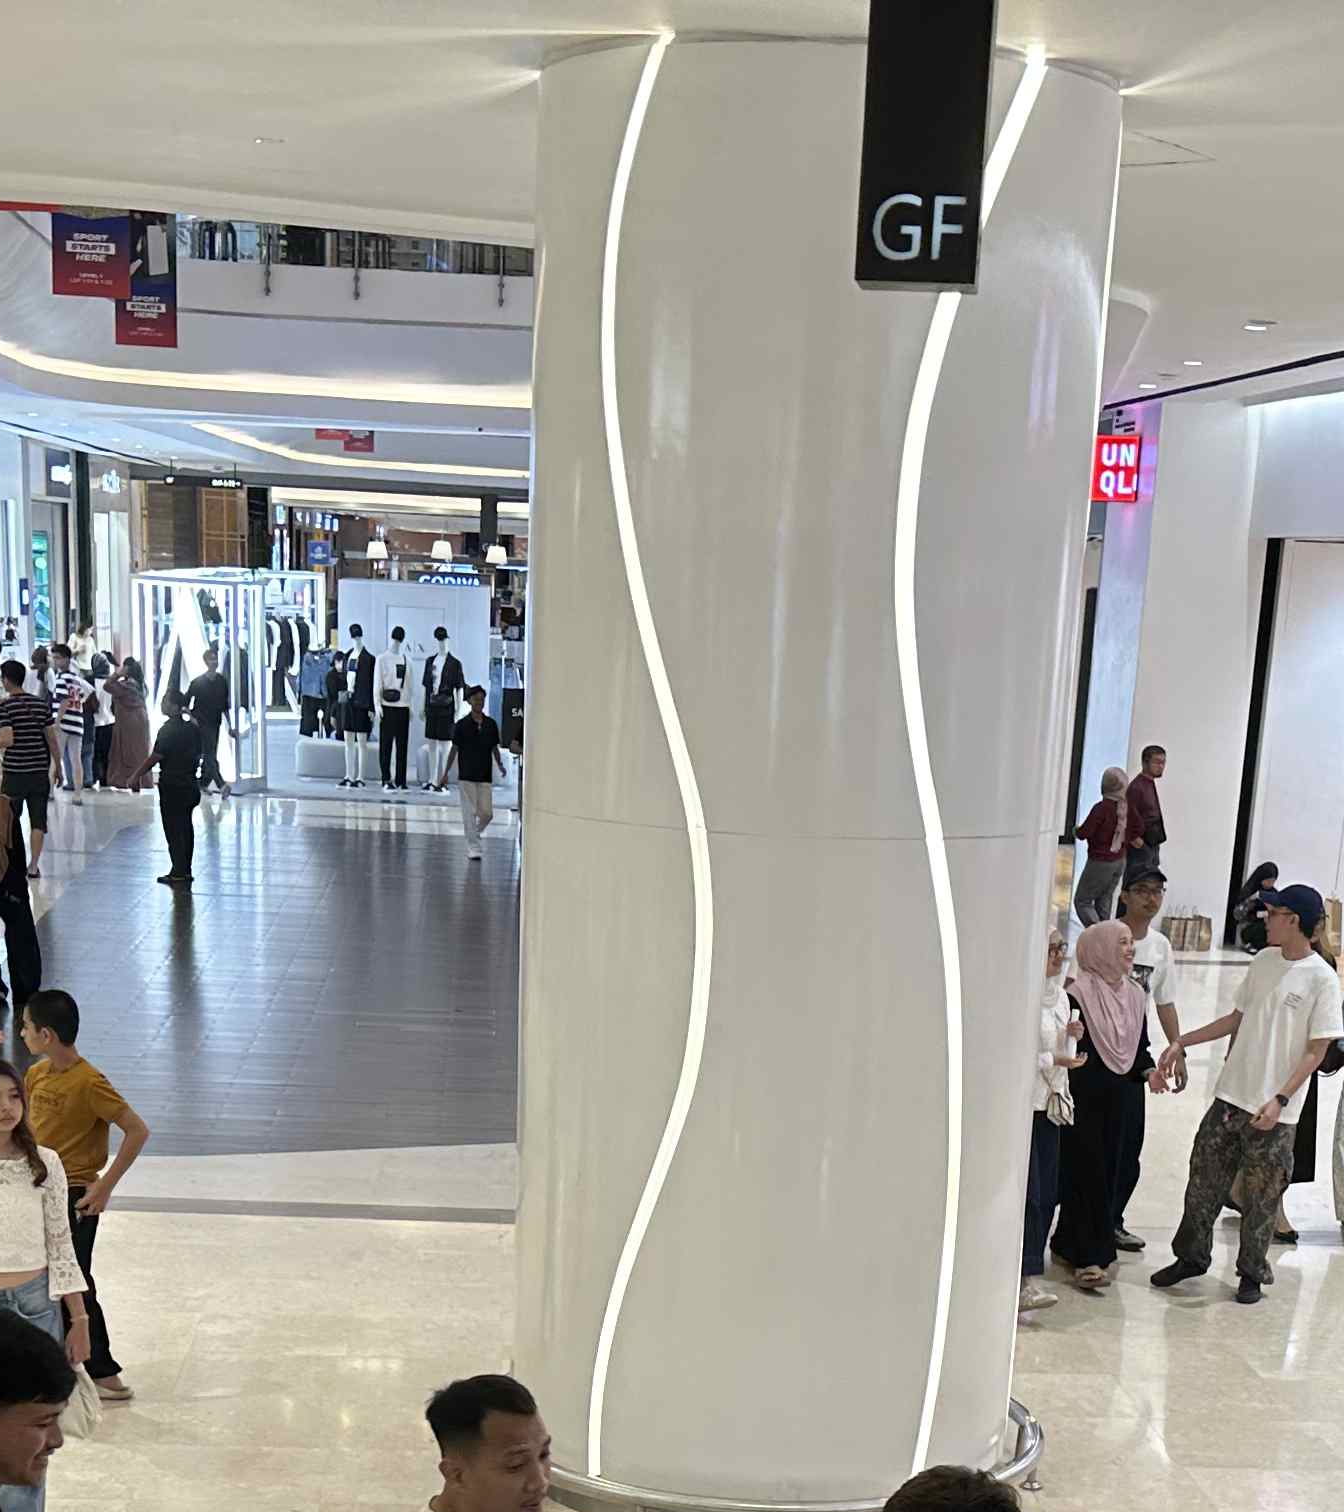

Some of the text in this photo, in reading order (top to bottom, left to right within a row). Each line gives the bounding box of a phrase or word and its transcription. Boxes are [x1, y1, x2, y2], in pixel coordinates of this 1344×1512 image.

[872, 193, 967, 260] GF
[72, 232, 109, 241] SPORT
[70, 243, 111, 252] STARTS
[76, 254, 107, 262] HERE
